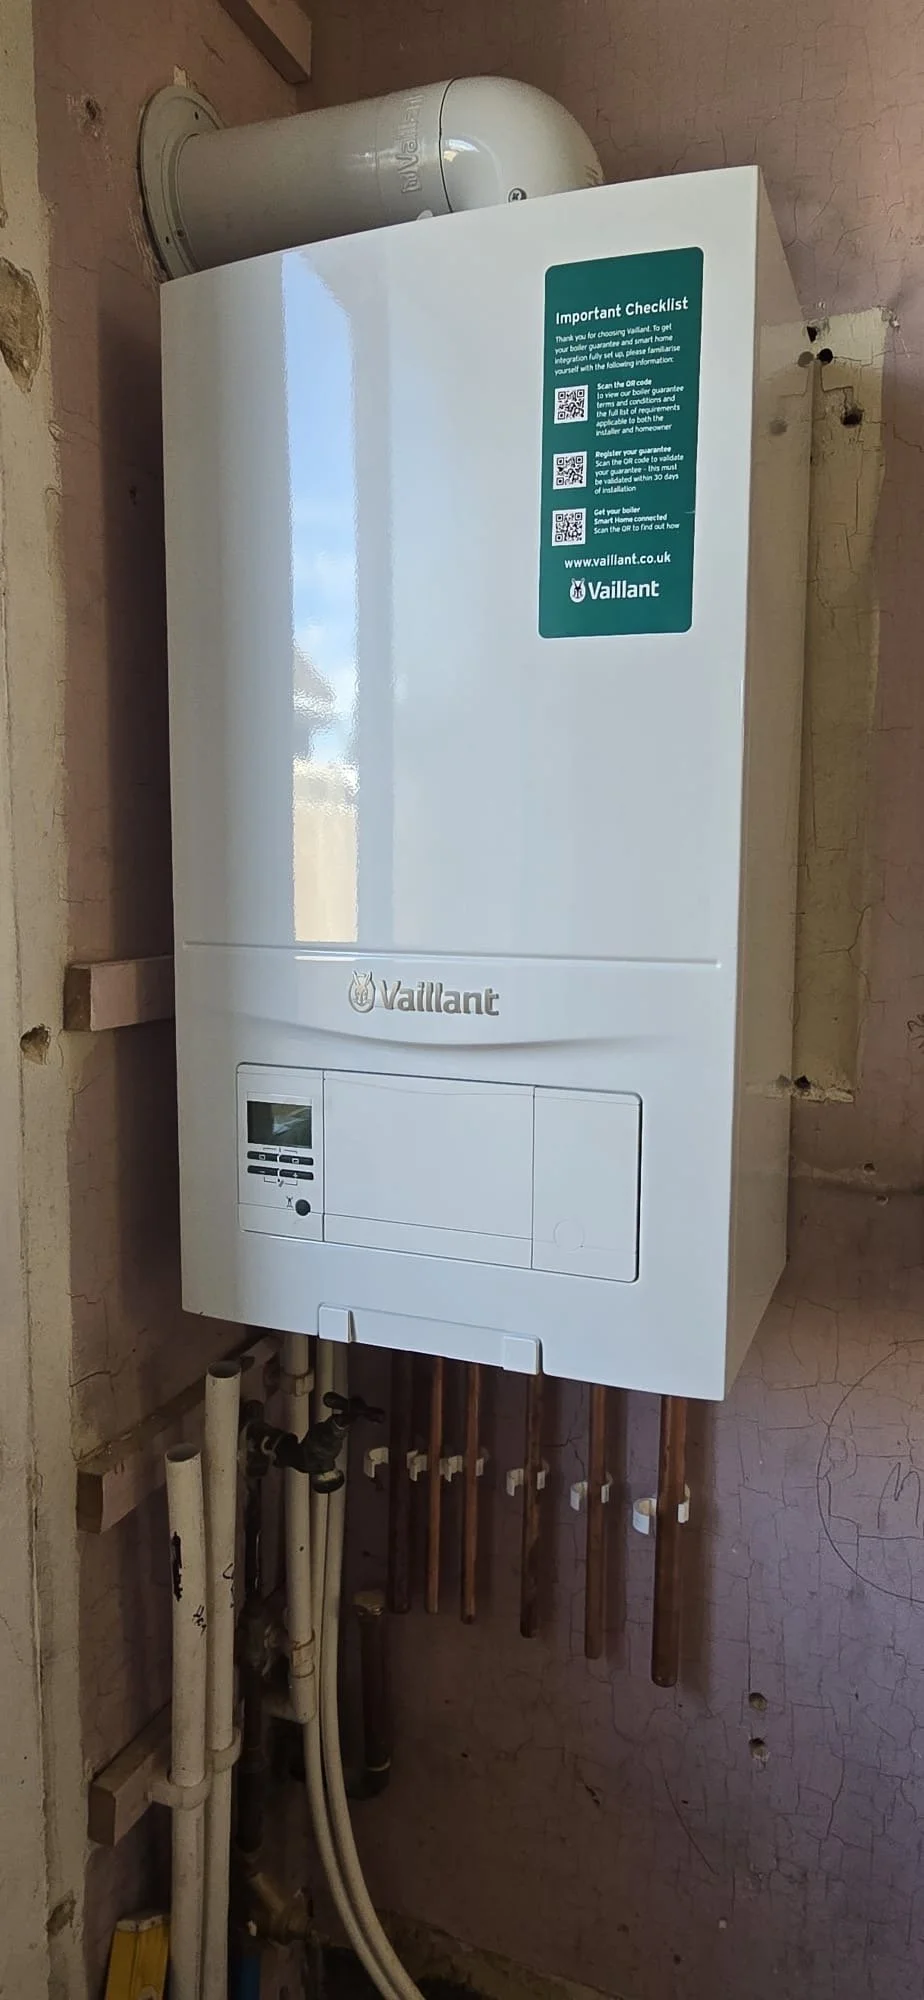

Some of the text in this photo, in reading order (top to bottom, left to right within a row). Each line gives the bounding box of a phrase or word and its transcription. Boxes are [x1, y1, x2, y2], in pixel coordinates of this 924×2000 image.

[556, 296, 688, 326] Important Checklist
[555, 334, 574, 343] Thank
[574, 334, 586, 342] you
[587, 331, 596, 339] for
[597, 329, 626, 338] choosing
[661, 323, 672, 333] get
[555, 347, 569, 355] your
[570, 344, 588, 352] boiler
[588, 341, 620, 352] guarantee
[621, 338, 633, 346] and
[634, 336, 653, 345] smart
[554, 355, 588, 365] integration
[589, 352, 602, 360] fully
[604, 351, 613, 359] set
[626, 349, 646, 358] please
[647, 345, 680, 354] familiarise
[554, 365, 579, 376] yourself
[580, 364, 594, 372] with
[606, 361, 634, 369] following
[636, 378, 652, 386] code
[597, 392, 604, 400] to
[632, 388, 651, 396] boiler
[651, 385, 684, 396] guarantee
[596, 394, 675, 409] terms and conditions and
[608, 409, 618, 417] full
[630, 407, 637, 415] of
[638, 404, 680, 414] requirements
[596, 418, 628, 428] applicable
[596, 424, 672, 436] installer and homeowner
[595, 446, 672, 459] Register your guarantee
[634, 456, 650, 464] code
[659, 454, 684, 462] validate
[610, 466, 642, 477] guarantee
[661, 463, 677, 471] must
[603, 476, 632, 484] validated
[594, 485, 637, 495] of installation
[594, 508, 606, 516] Get
[622, 506, 640, 514] boiler
[594, 517, 613, 525] Smart
[634, 514, 668, 522] connected
[640, 523, 653, 531] find
[564, 551, 671, 568] www.vaillant.co.uk
[588, 580, 660, 600] Vaillant
[380, 980, 500, 1016] Vaillant
